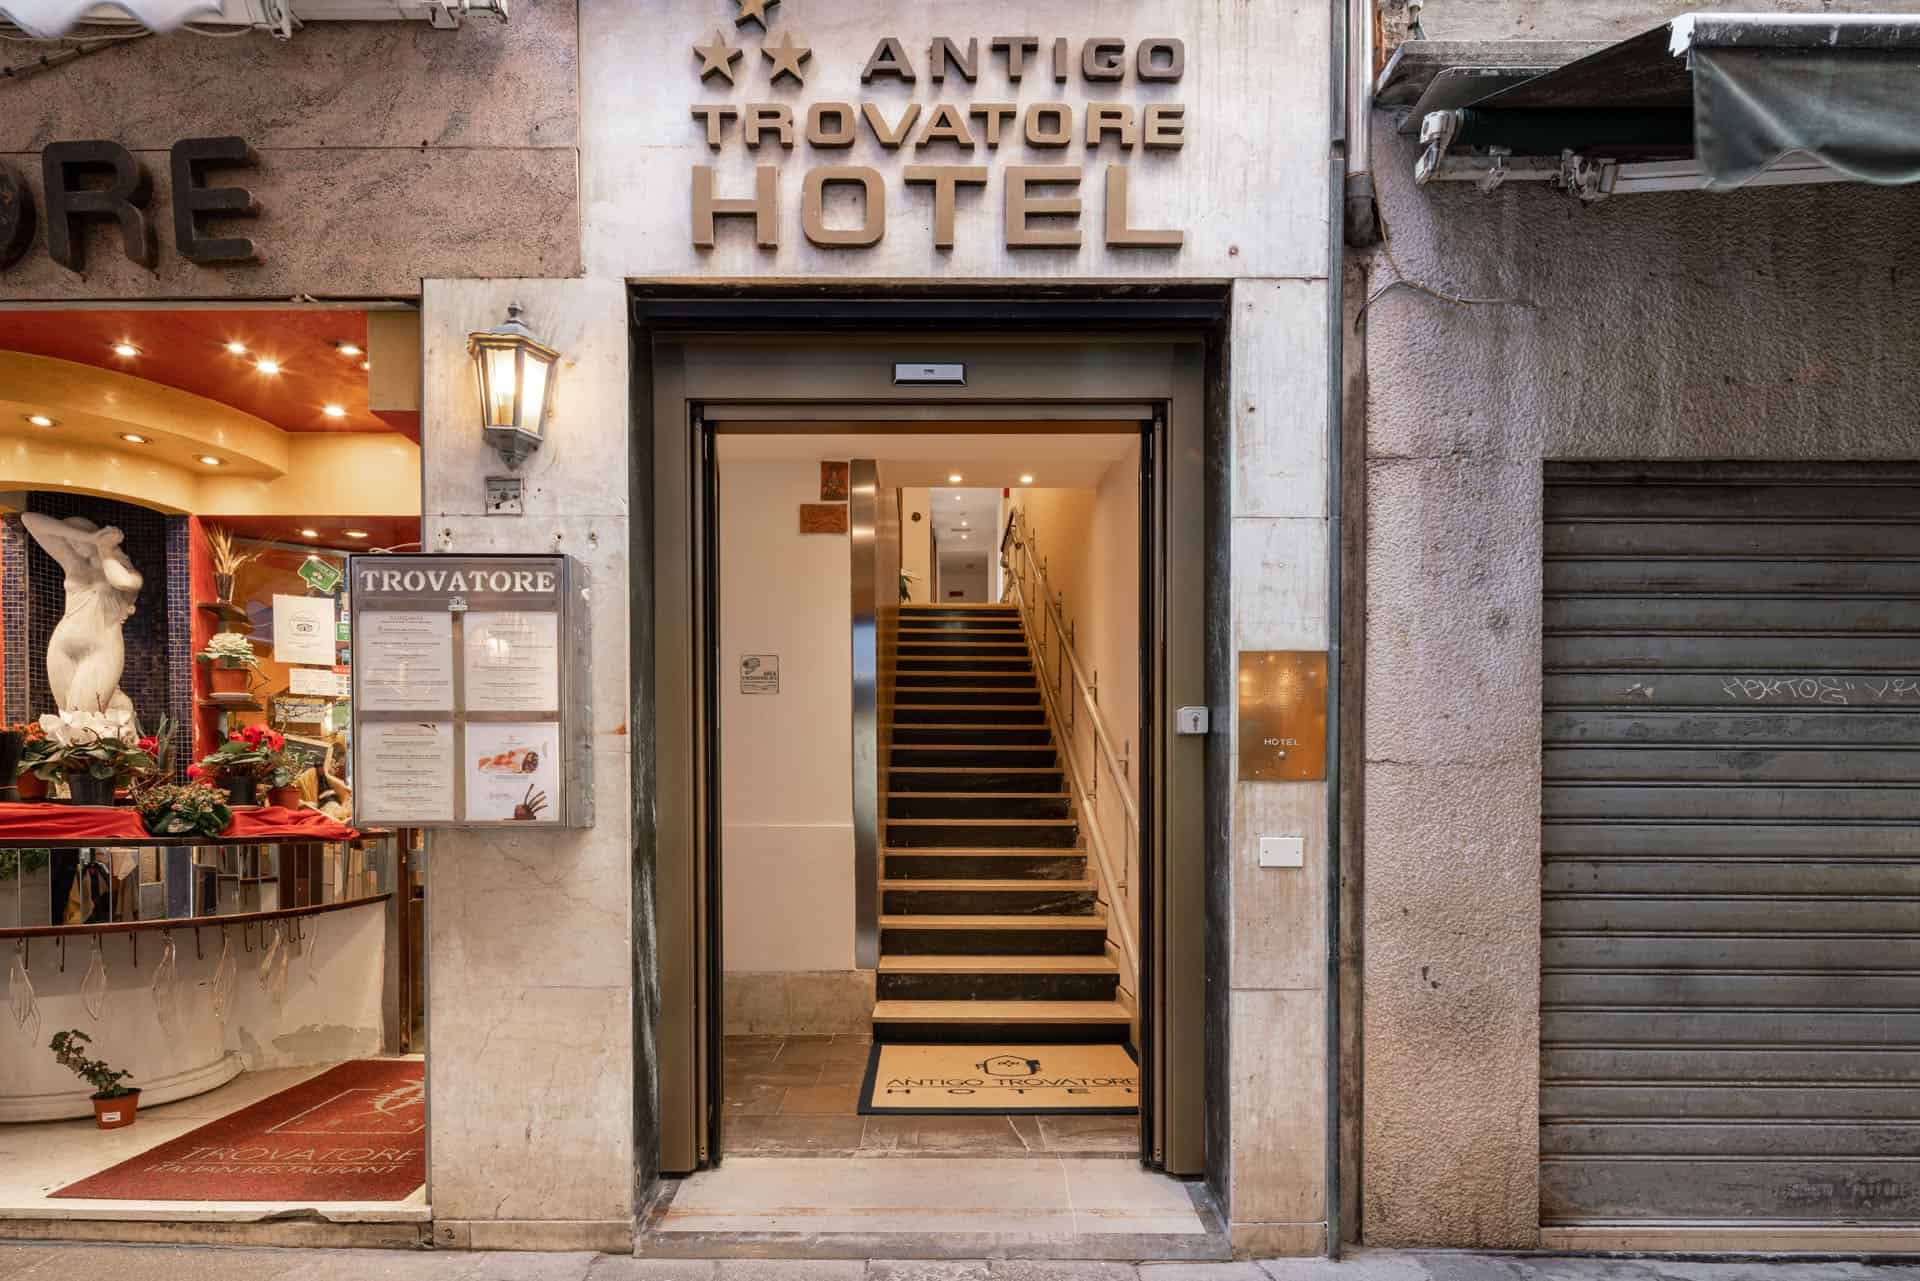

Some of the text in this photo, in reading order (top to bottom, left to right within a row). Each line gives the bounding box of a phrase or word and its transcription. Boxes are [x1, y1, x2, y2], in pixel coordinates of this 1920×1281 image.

[860, 37, 1185, 83] ANTIGO
[691, 102, 1185, 149] TROVATORE
[0, 136, 262, 270] RE
[691, 165, 1184, 249] HOTEL
[360, 570, 555, 593] TROVATORE
[1264, 737, 1301, 746] HOTEL
[887, 1078, 984, 1087] ANTIGO
[181, 1147, 421, 1161] TROVATORE
